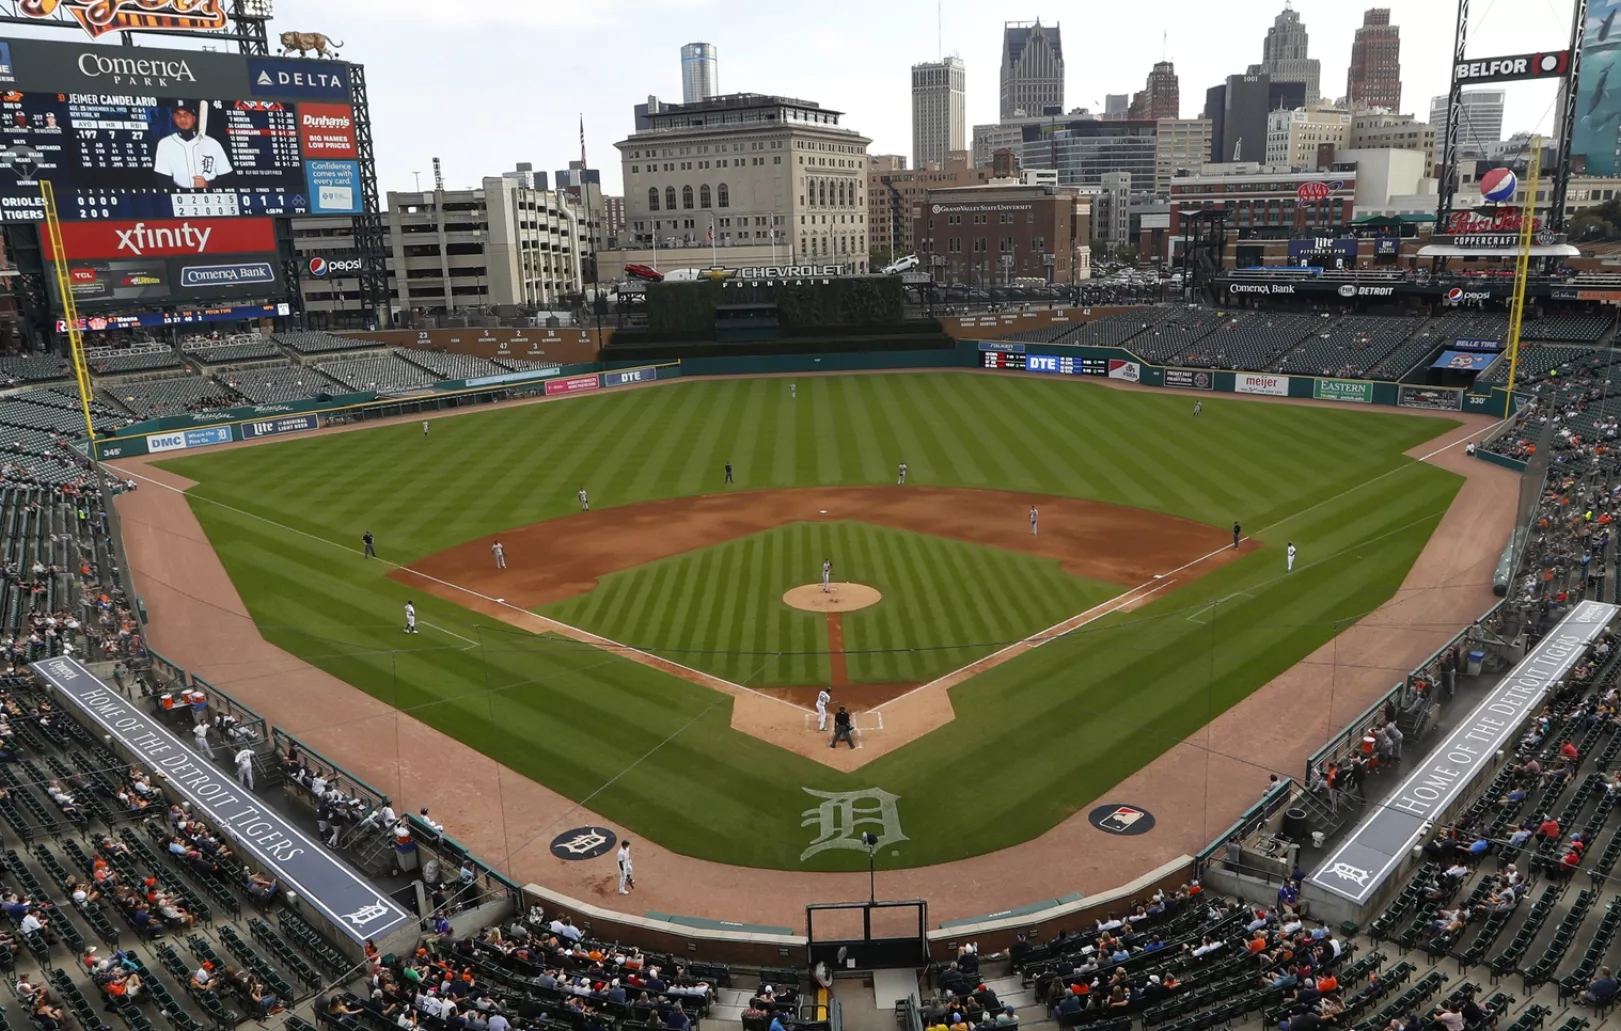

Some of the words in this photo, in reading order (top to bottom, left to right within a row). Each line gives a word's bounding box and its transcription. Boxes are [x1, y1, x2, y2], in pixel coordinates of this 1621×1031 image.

[1457, 58, 1526, 78] BELFOR
[114, 76, 167, 87] PARK
[278, 72, 342, 88] DELTA
[68, 94, 99, 104] JEIMER
[100, 94, 157, 107] CANDELARIO
[213, 100, 222, 109] 46
[303, 114, 350, 127] Dunham's
[76, 130, 97, 139] .197
[108, 130, 115, 139] 7
[132, 131, 143, 140] 27
[312, 162, 352, 170] Confidence
[1300, 184, 1327, 198] AAA
[2, 197, 49, 206] ORIOLES
[78, 196, 84, 206] 0
[89, 196, 96, 206] 0
[100, 196, 107, 205] 0
[111, 196, 117, 205] 0
[177, 196, 183, 204] 0
[192, 196, 197, 204] 2
[243, 195, 250, 206] 0
[260, 195, 267, 206] 1
[278, 195, 284, 206] 1
[4, 210, 44, 220] TIGERS
[80, 209, 87, 218] 2
[91, 209, 98, 218] 0
[102, 209, 109, 218] 0
[115, 222, 212, 254] xfinity
[1315, 237, 1334, 249] Lite
[1454, 236, 1518, 245] COPPERCRAFT
[329, 258, 362, 272] pepsi
[240, 267, 266, 277] Bank
[741, 265, 844, 278] CHEVROLET
[723, 279, 829, 288] FOUNTAIN
[1272, 284, 1295, 293] Bank
[1358, 287, 1394, 296] DETROIT
[1464, 291, 1490, 300] pepsi
[1030, 357, 1056, 369] DTE
[621, 372, 641, 382] DTE
[1246, 376, 1277, 388] meijer
[1321, 380, 1366, 392] EASTERN
[253, 422, 273, 435] Lite
[152, 436, 182, 448] DMC
[1396, 769, 1460, 816] HOME
[1448, 744, 1477, 765] OF
[1466, 717, 1505, 751] THE
[1488, 665, 1549, 716] DETROIT
[1538, 633, 1579, 671] TIGERS
[80, 688, 124, 722] HOME
[115, 716, 147, 739] OF
[135, 730, 171, 761] THE
[160, 753, 237, 822] DETROIT
[234, 804, 304, 862] TIGERS
